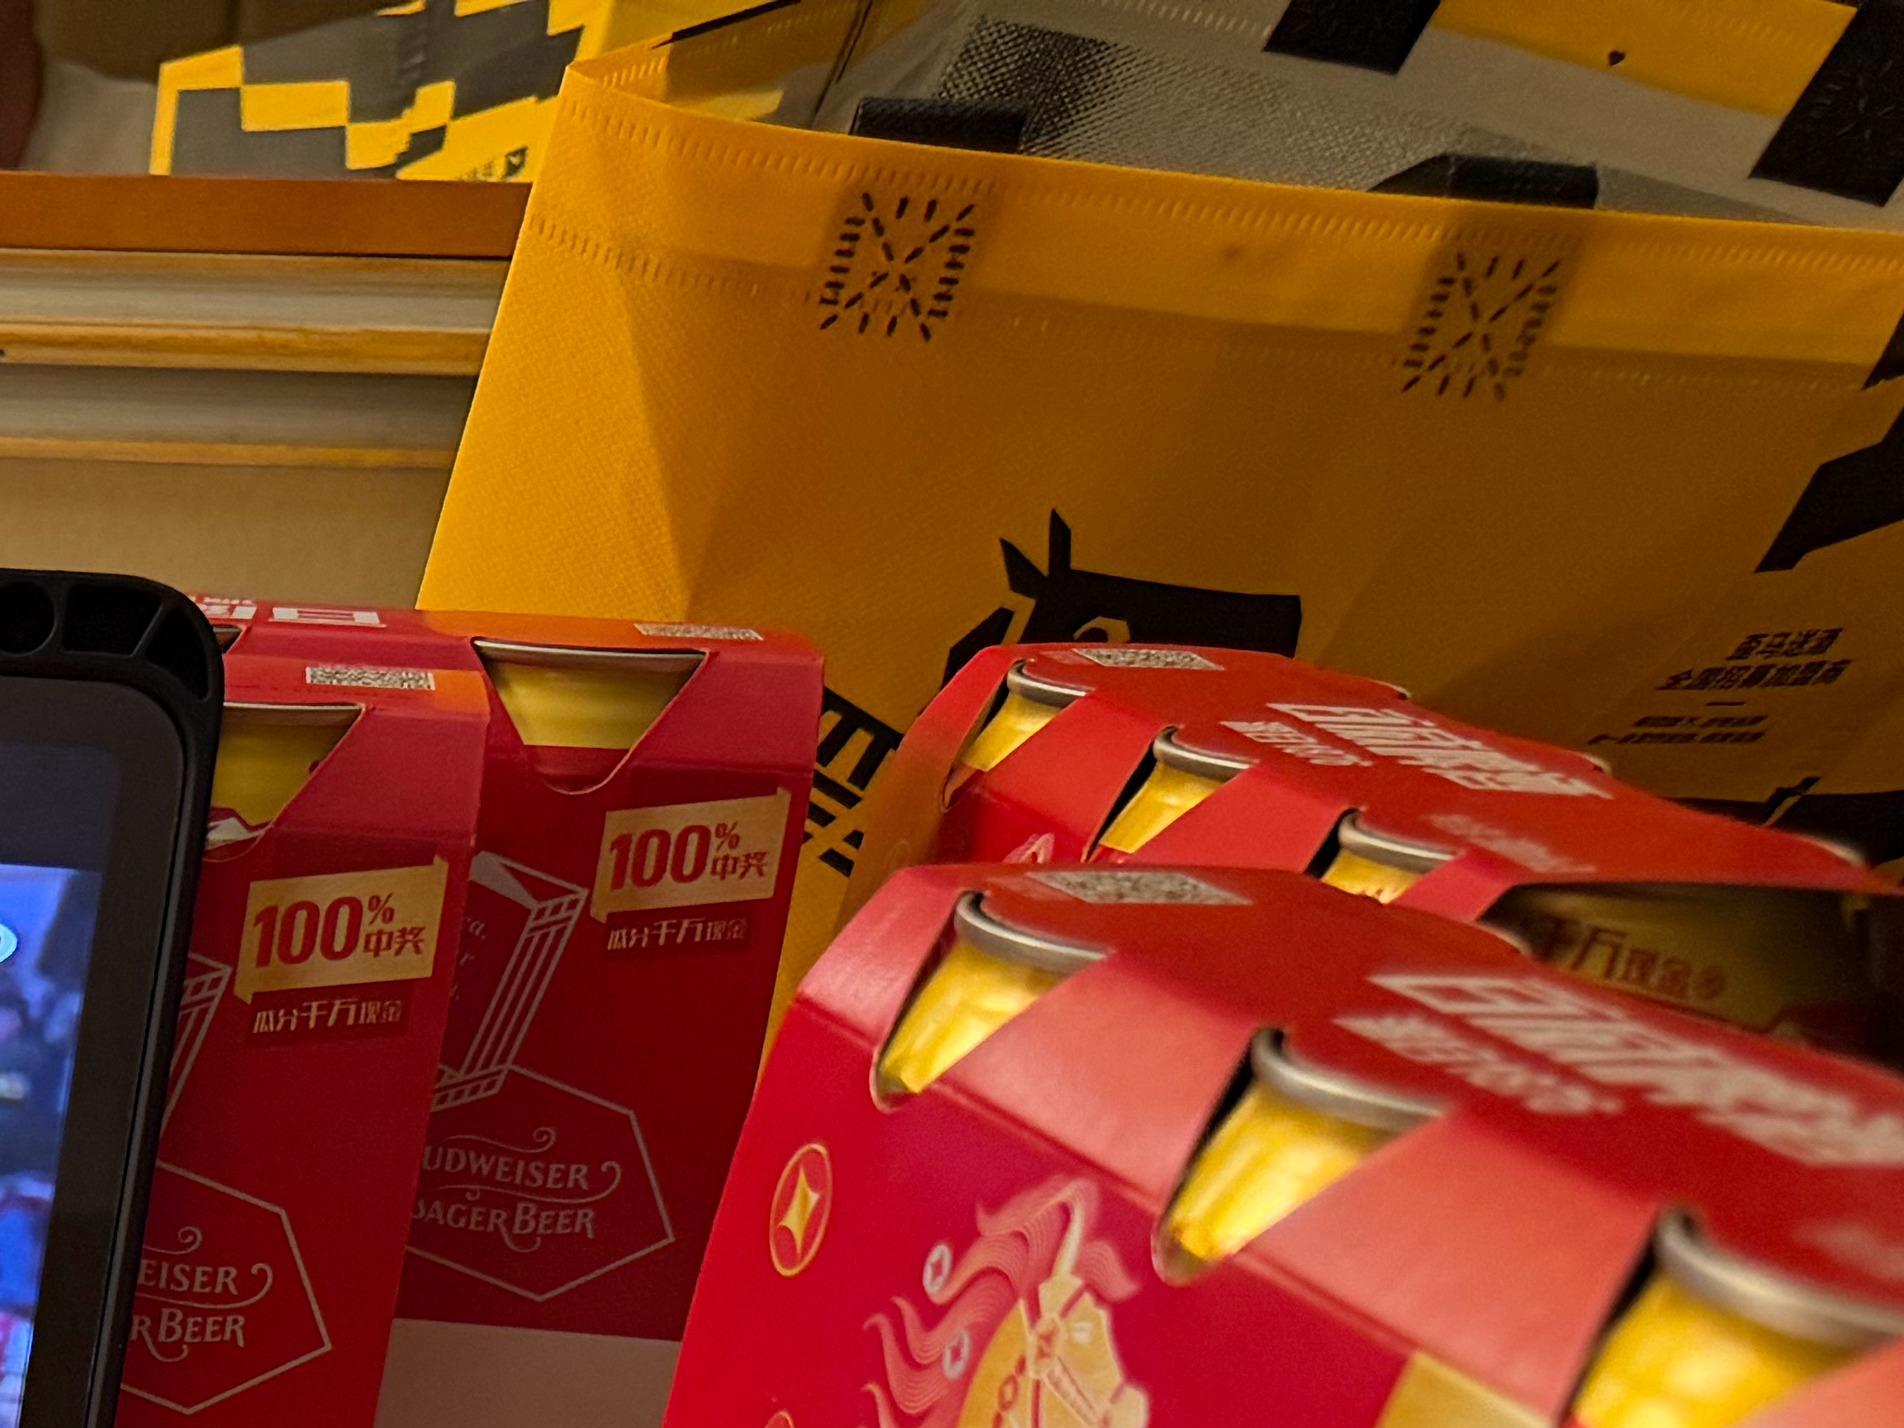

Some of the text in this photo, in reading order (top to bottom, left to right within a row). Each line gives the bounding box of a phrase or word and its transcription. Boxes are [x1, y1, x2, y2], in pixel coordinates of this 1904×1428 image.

[607, 822, 769, 894] 100% 中奖
[252, 893, 395, 969] 100%
[362, 924, 427, 960] 中奖
